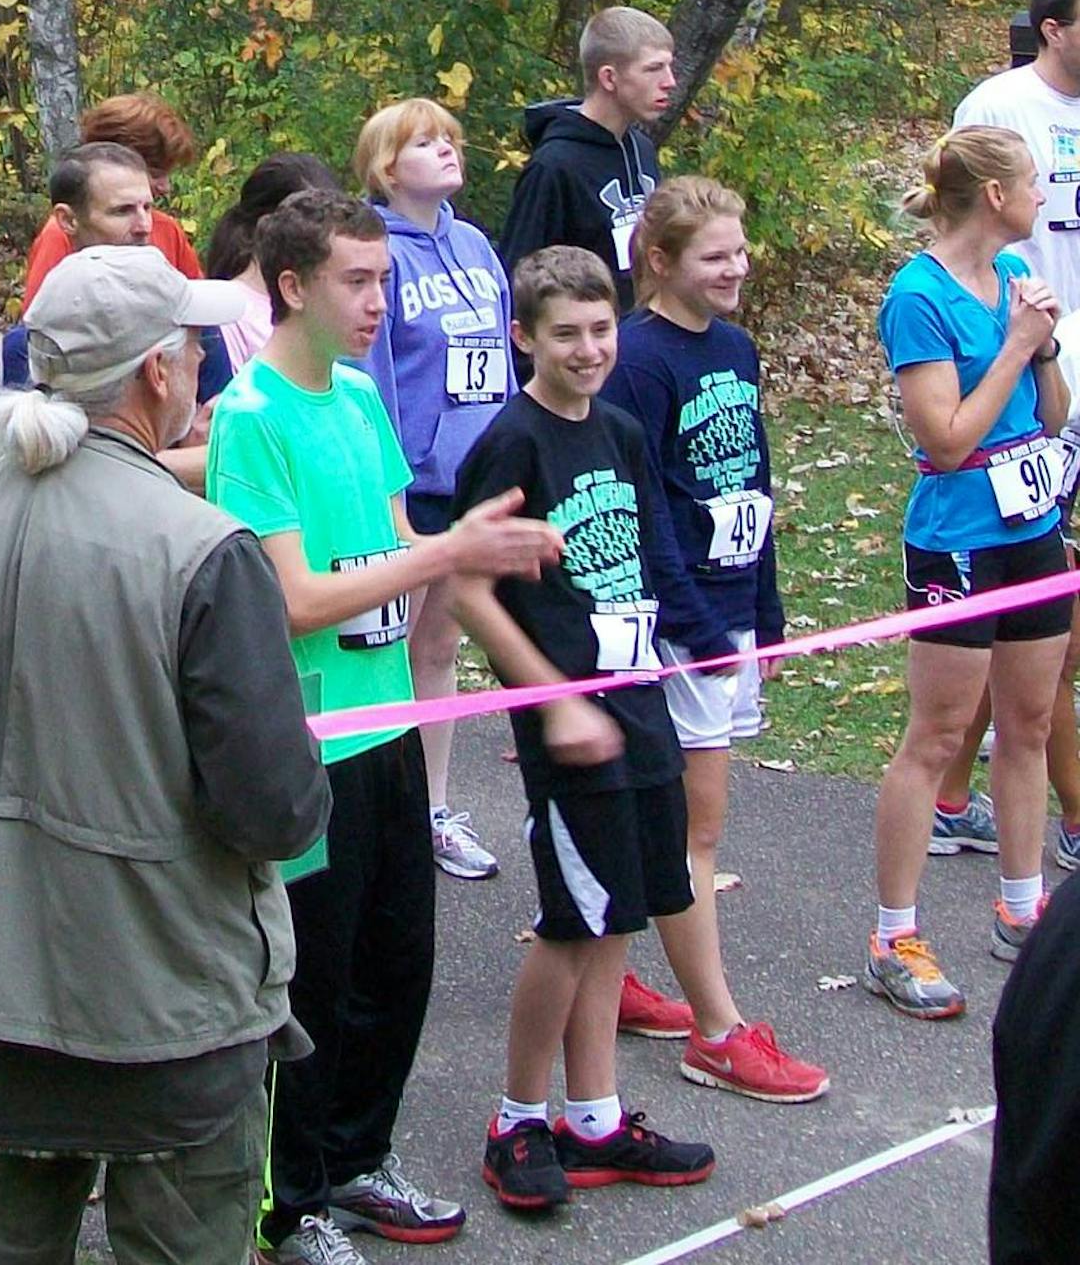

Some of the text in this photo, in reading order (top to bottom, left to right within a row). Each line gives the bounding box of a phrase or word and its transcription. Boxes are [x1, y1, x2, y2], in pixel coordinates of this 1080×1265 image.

[401, 266, 500, 324] BOSTON
[466, 349, 489, 390] 13
[1020, 453, 1051, 504] 90
[730, 503, 756, 553] 49
